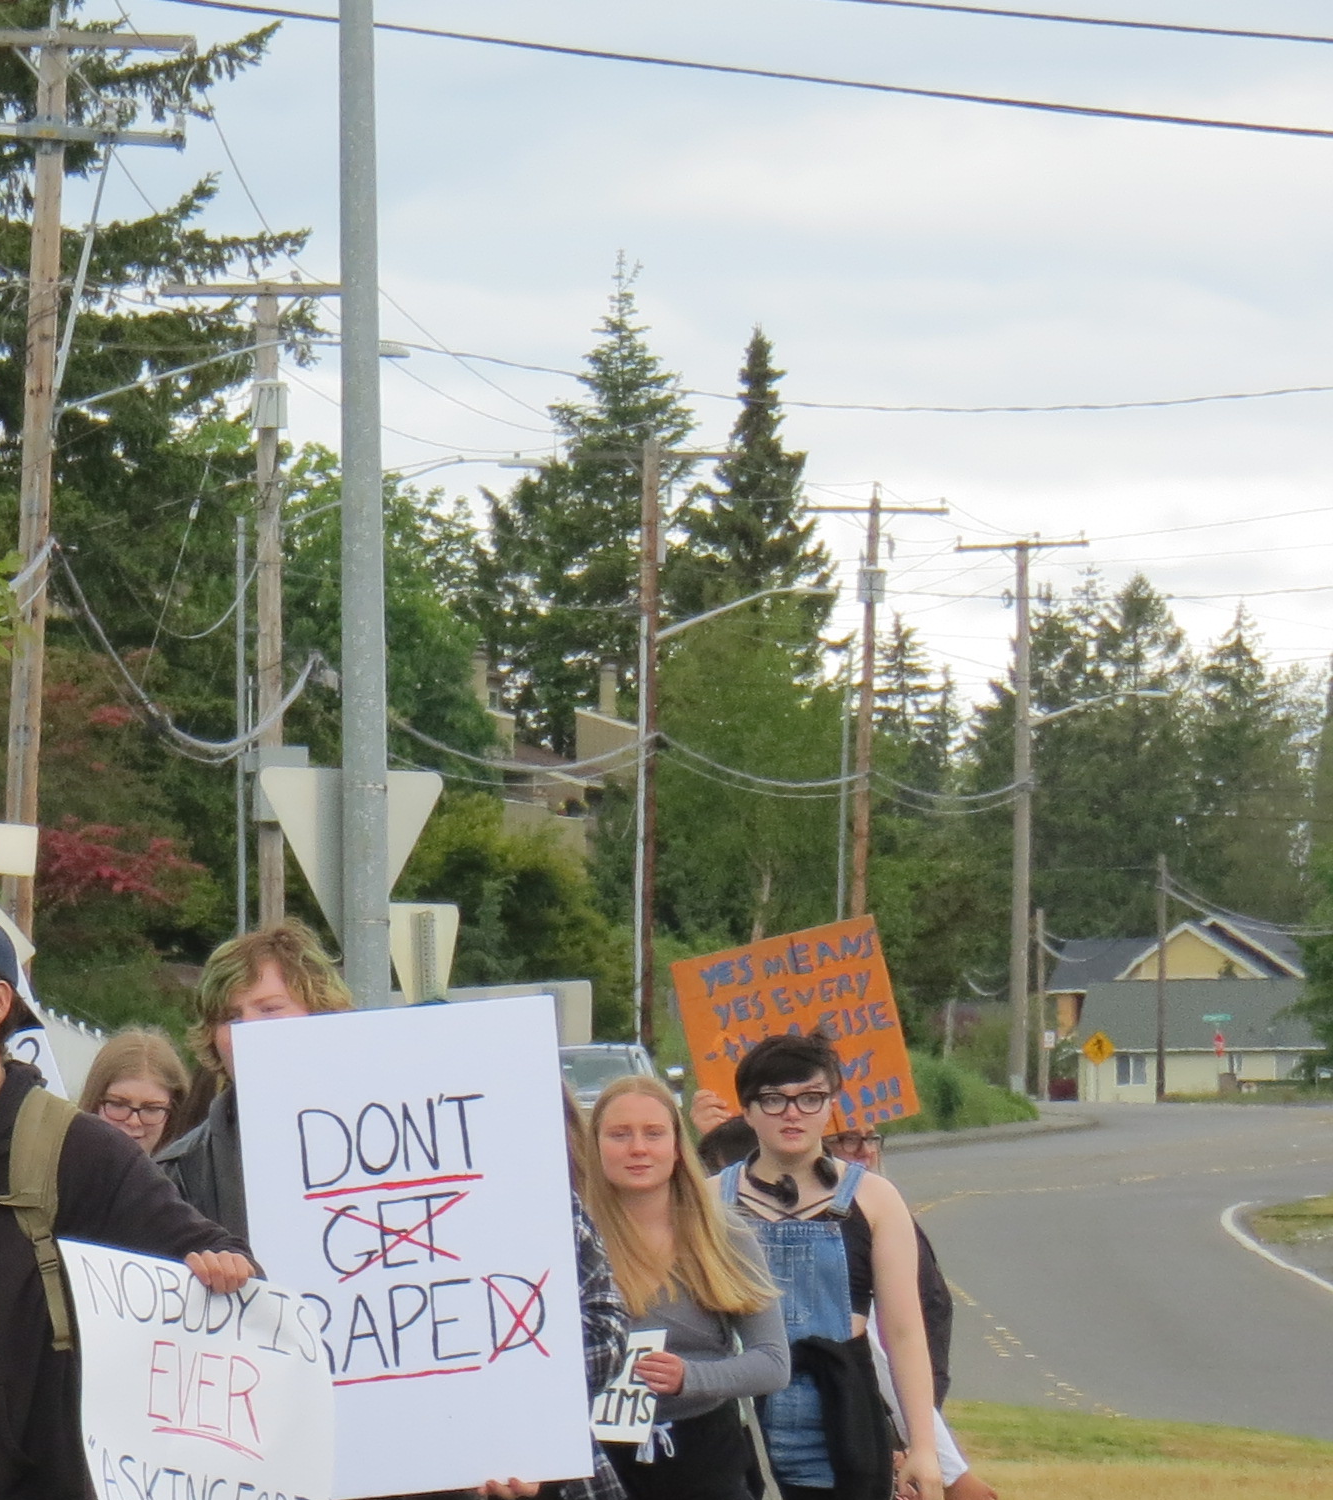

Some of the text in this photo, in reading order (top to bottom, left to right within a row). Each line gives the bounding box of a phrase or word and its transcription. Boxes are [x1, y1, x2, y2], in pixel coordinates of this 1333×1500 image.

[699, 954, 754, 998] YES
[713, 969, 871, 1030] YES EVERY
[322, 1191, 461, 1277] GET
[81, 1255, 317, 1363] NOBODY IS
[147, 1340, 261, 1444] EVER
